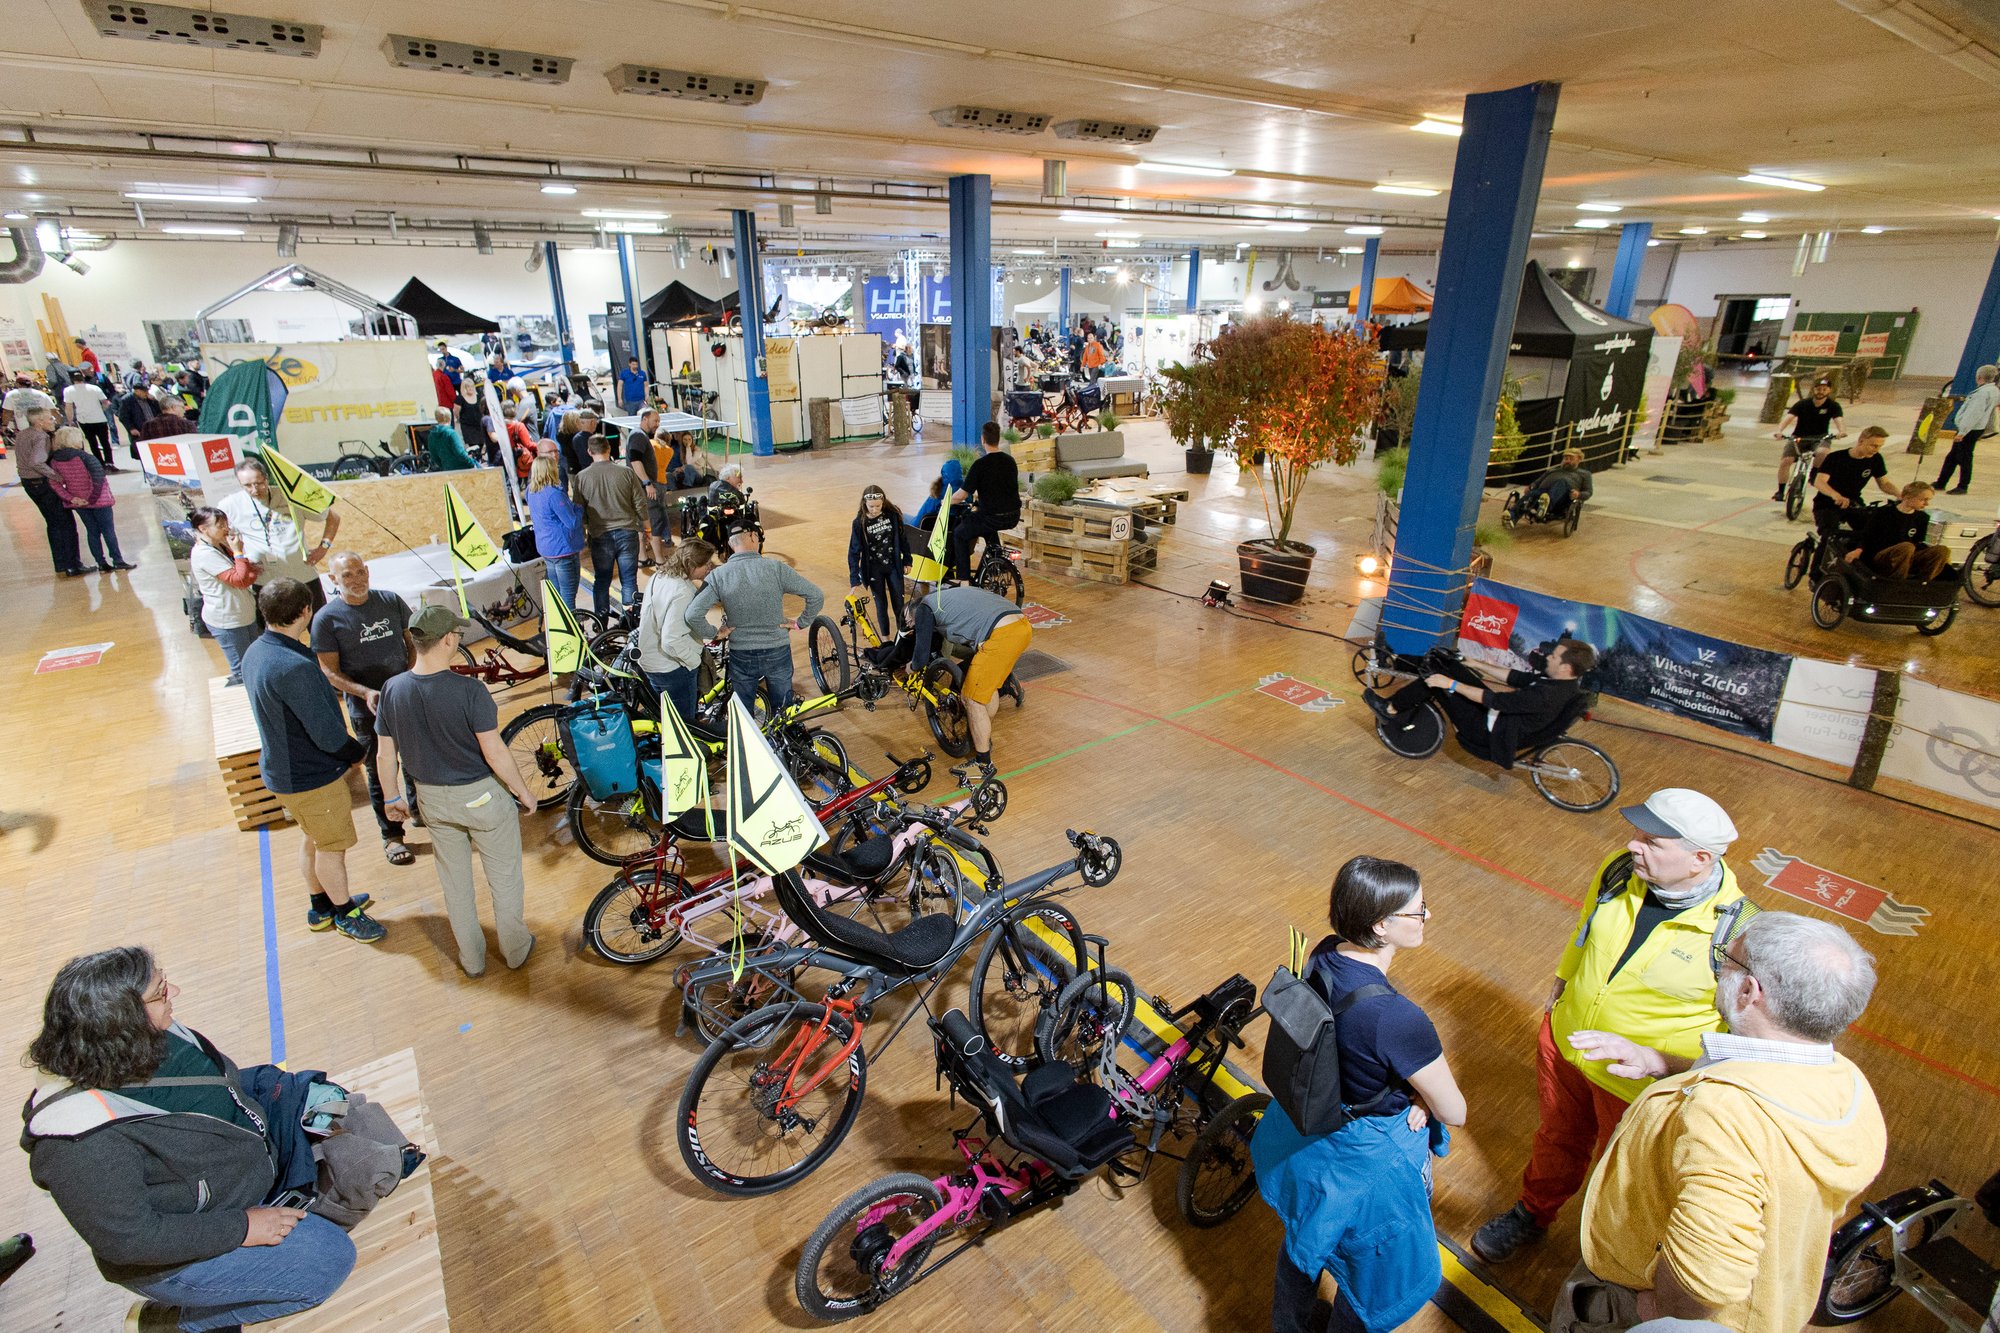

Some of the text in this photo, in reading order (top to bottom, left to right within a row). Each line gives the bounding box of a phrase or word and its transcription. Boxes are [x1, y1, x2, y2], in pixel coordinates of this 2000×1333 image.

[1115, 523, 1126, 533] 10
[1654, 655, 1748, 696] Viktor Zichó
[1664, 681, 1695, 697] Unser
[760, 833, 803, 848] AZUB
